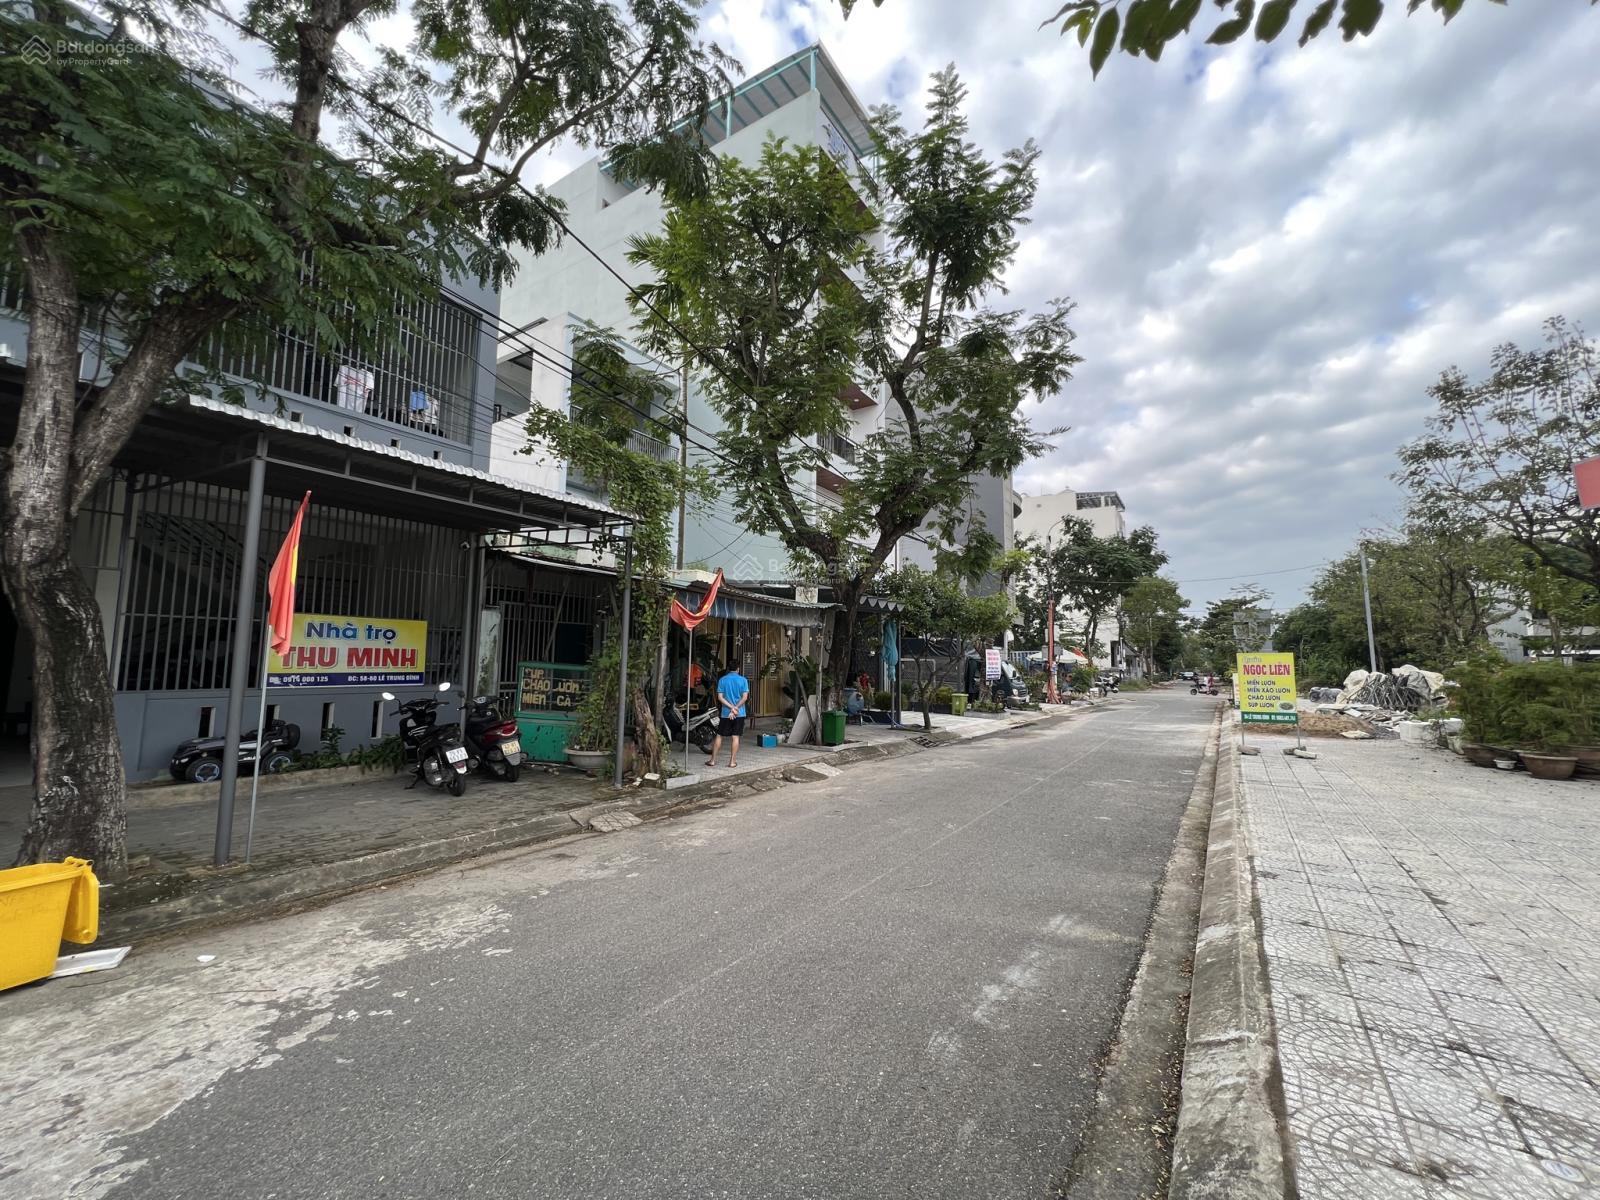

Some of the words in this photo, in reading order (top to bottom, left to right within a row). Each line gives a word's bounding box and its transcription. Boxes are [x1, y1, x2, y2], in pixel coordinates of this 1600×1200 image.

[306, 622, 358, 639] Nhà
[366, 624, 397, 644] trọ
[281, 646, 338, 668] THU
[346, 646, 418, 668] MINH
[1243, 664, 1267, 677] NGỌC
[1269, 661, 1291, 676] LIÊN
